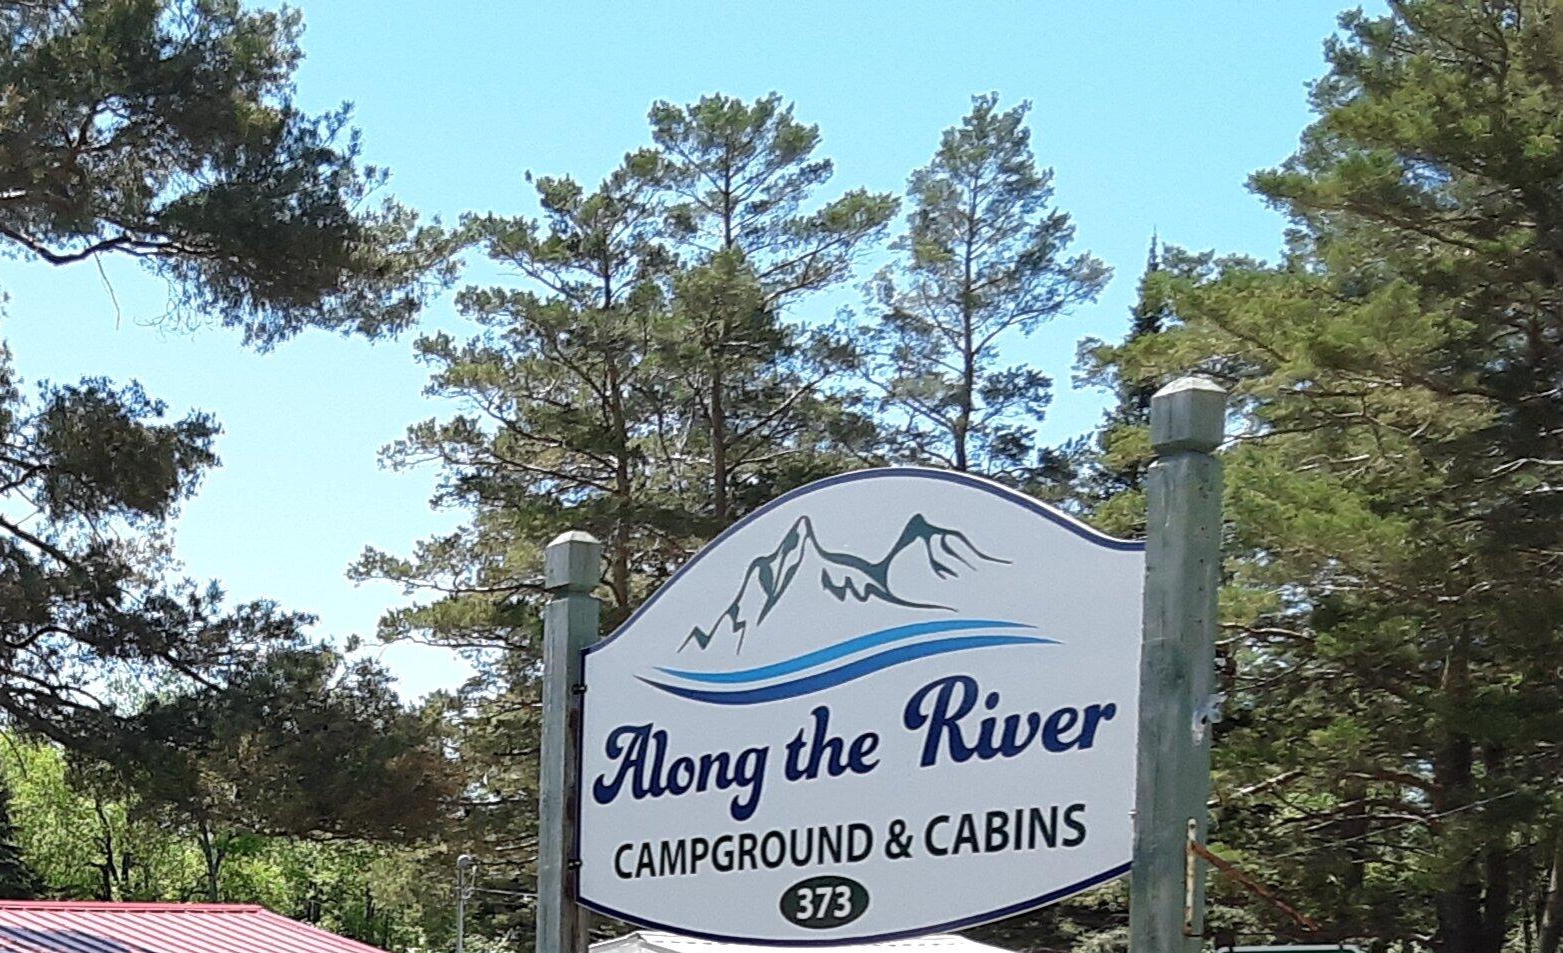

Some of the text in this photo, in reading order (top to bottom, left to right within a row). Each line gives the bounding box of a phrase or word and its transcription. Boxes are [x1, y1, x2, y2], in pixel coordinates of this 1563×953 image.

[591, 674, 1118, 822] Along the River
[613, 802, 1088, 880] CAMPGROUND & CABINS
[796, 884, 853, 920] 373
